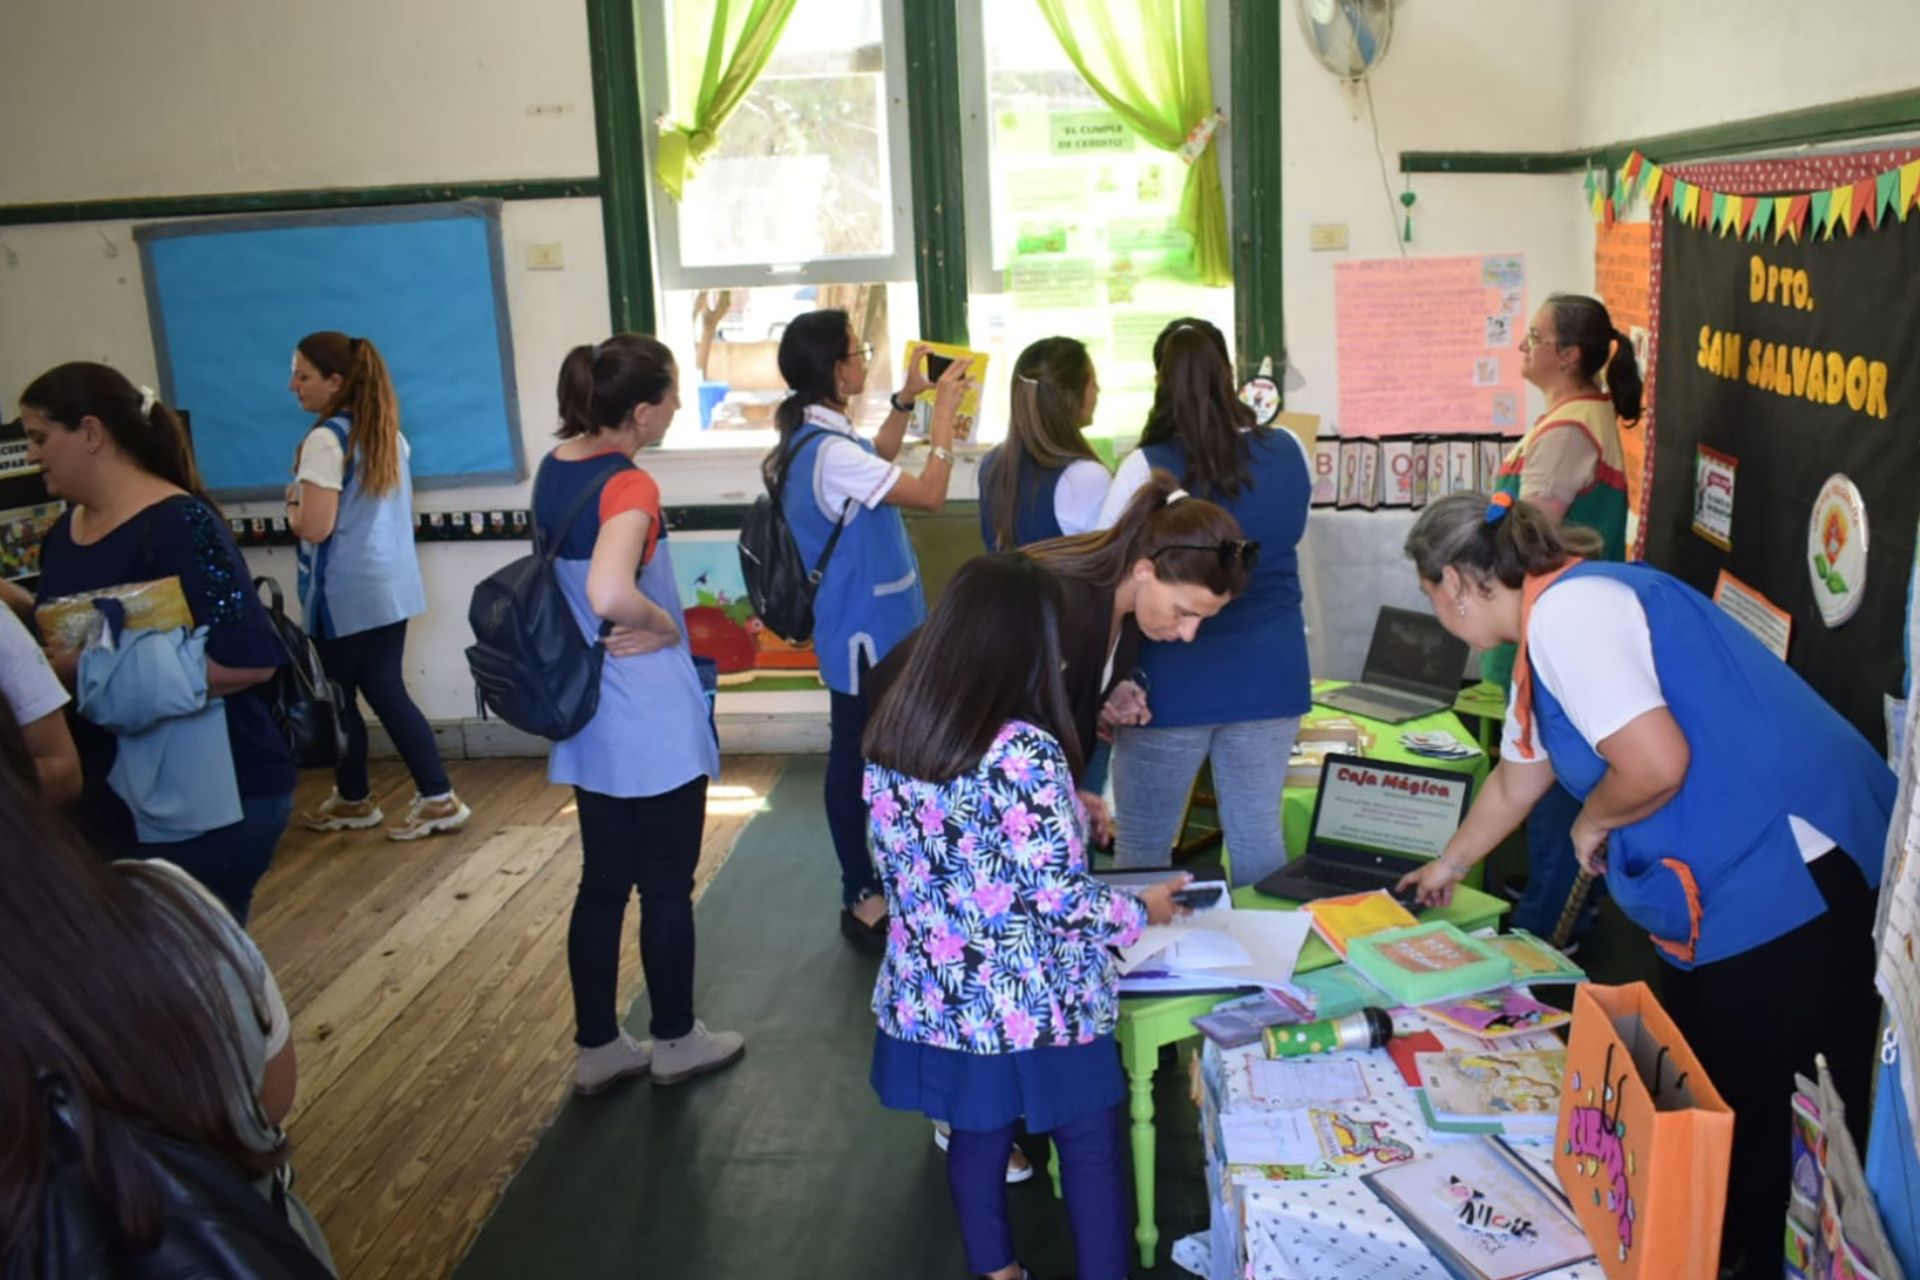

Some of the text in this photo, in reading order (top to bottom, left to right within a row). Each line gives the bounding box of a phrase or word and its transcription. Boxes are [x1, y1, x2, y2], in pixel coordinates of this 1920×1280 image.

[1697, 324, 1889, 420] SAN SALVADOR
[1337, 767, 1450, 798] Caja Mágica
